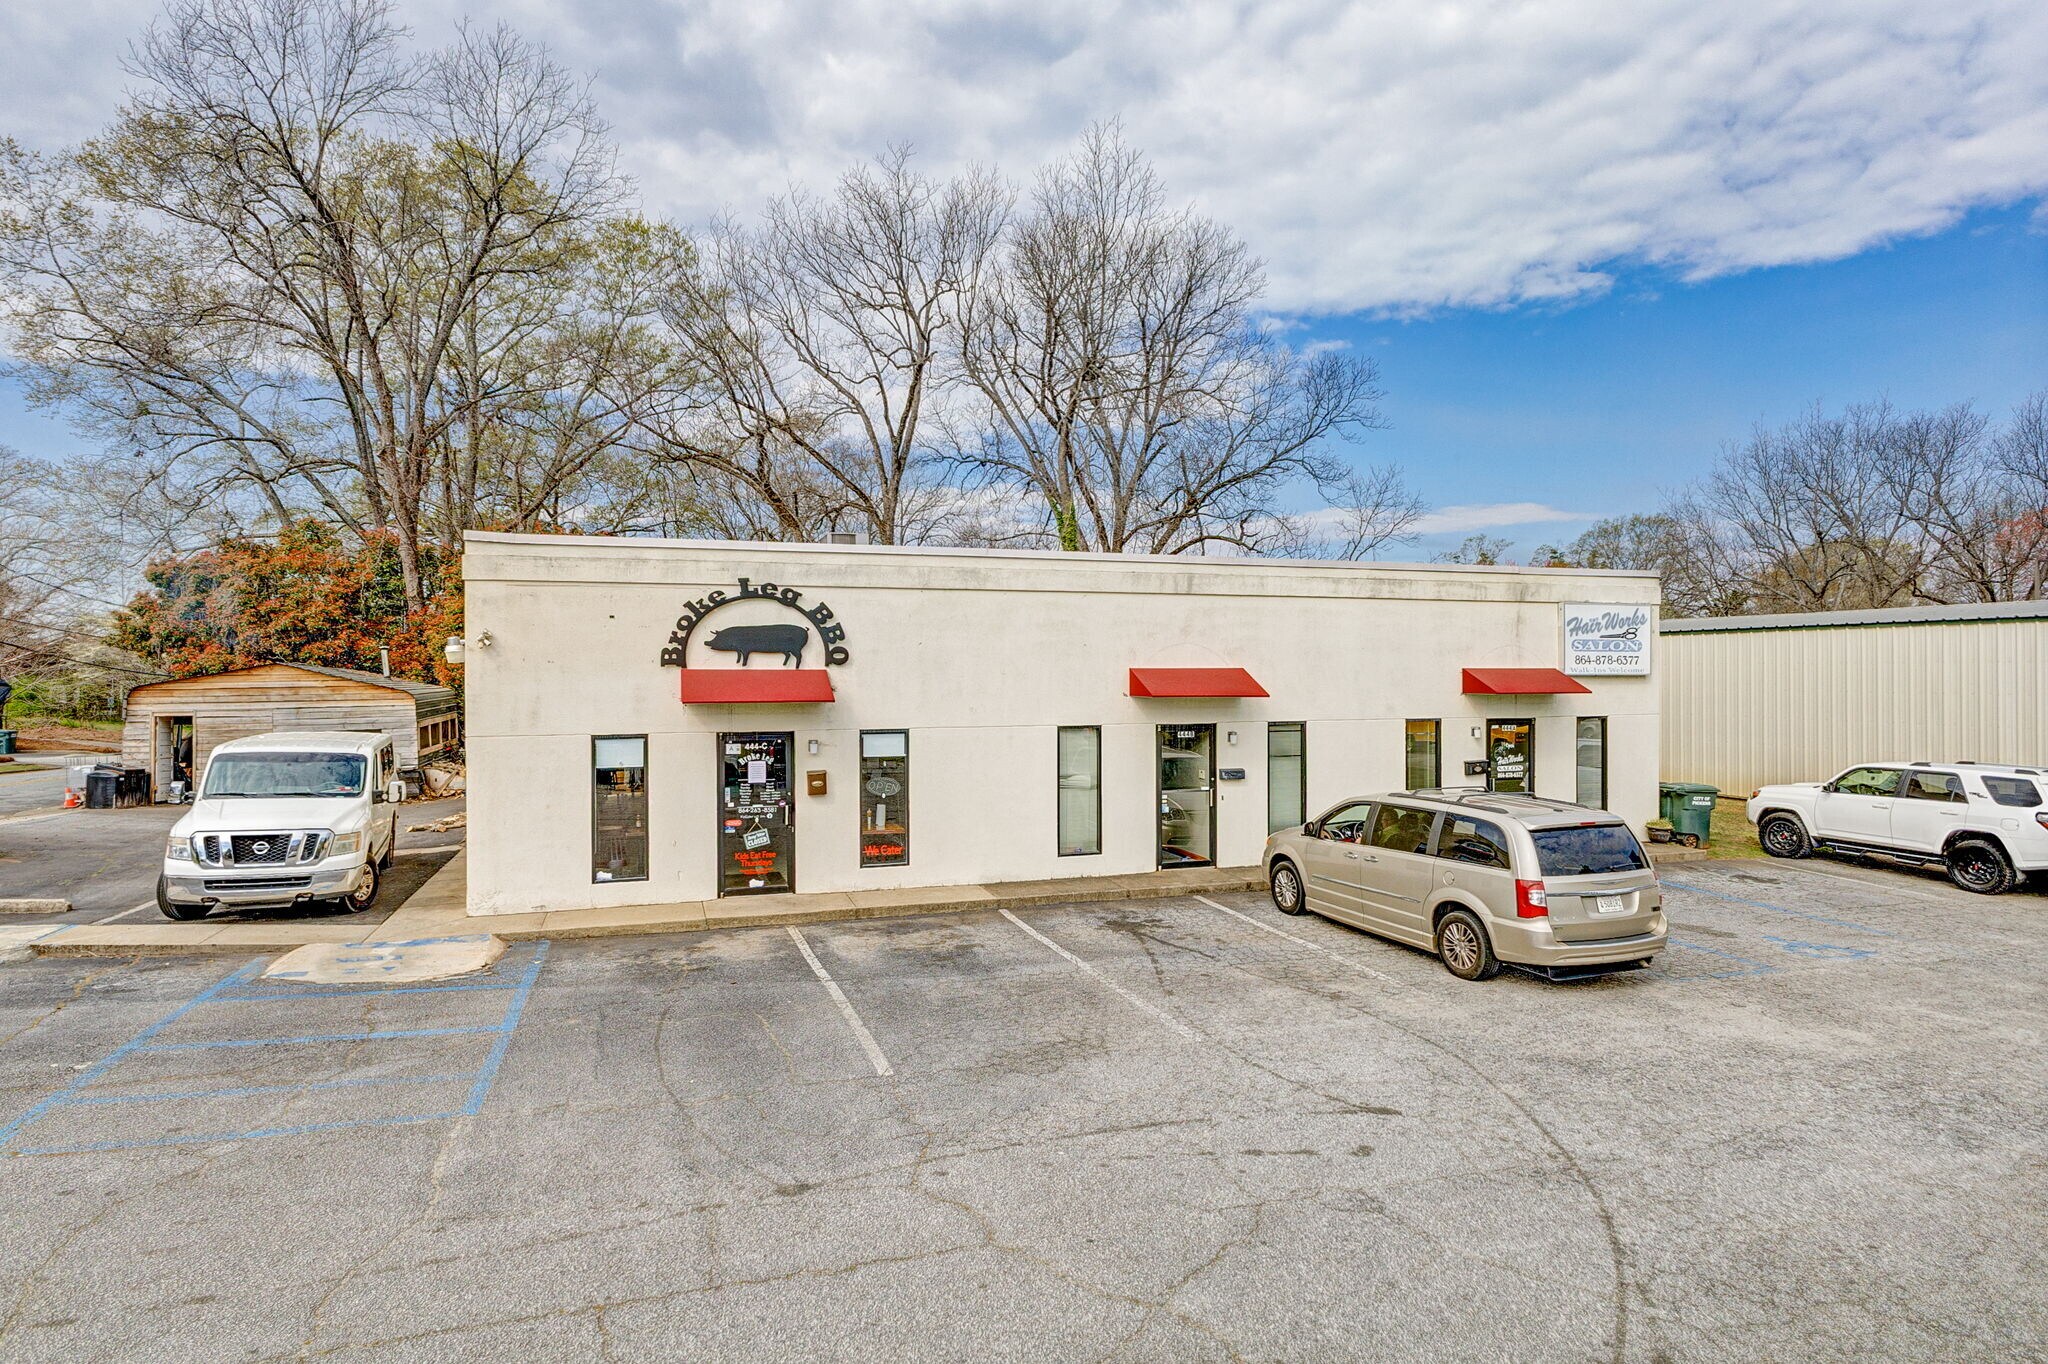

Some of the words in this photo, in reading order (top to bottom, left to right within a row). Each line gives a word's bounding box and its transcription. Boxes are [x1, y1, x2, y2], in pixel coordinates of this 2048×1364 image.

[660, 590, 727, 667] Broke
[738, 578, 802, 607] Leg
[1572, 640, 1639, 651] SALON
[1575, 655, 1640, 665] 864-878-6377
[744, 742, 768, 750] 444-C
[738, 752, 760, 766] Broke
[761, 753, 775, 765] Leg
[868, 781, 900, 792] OPEN
[734, 852, 749, 860] Kids
[750, 851, 761, 859] Eat
[762, 850, 777, 858] Free
[863, 845, 880, 856] We
[880, 845, 903, 855] Cater
